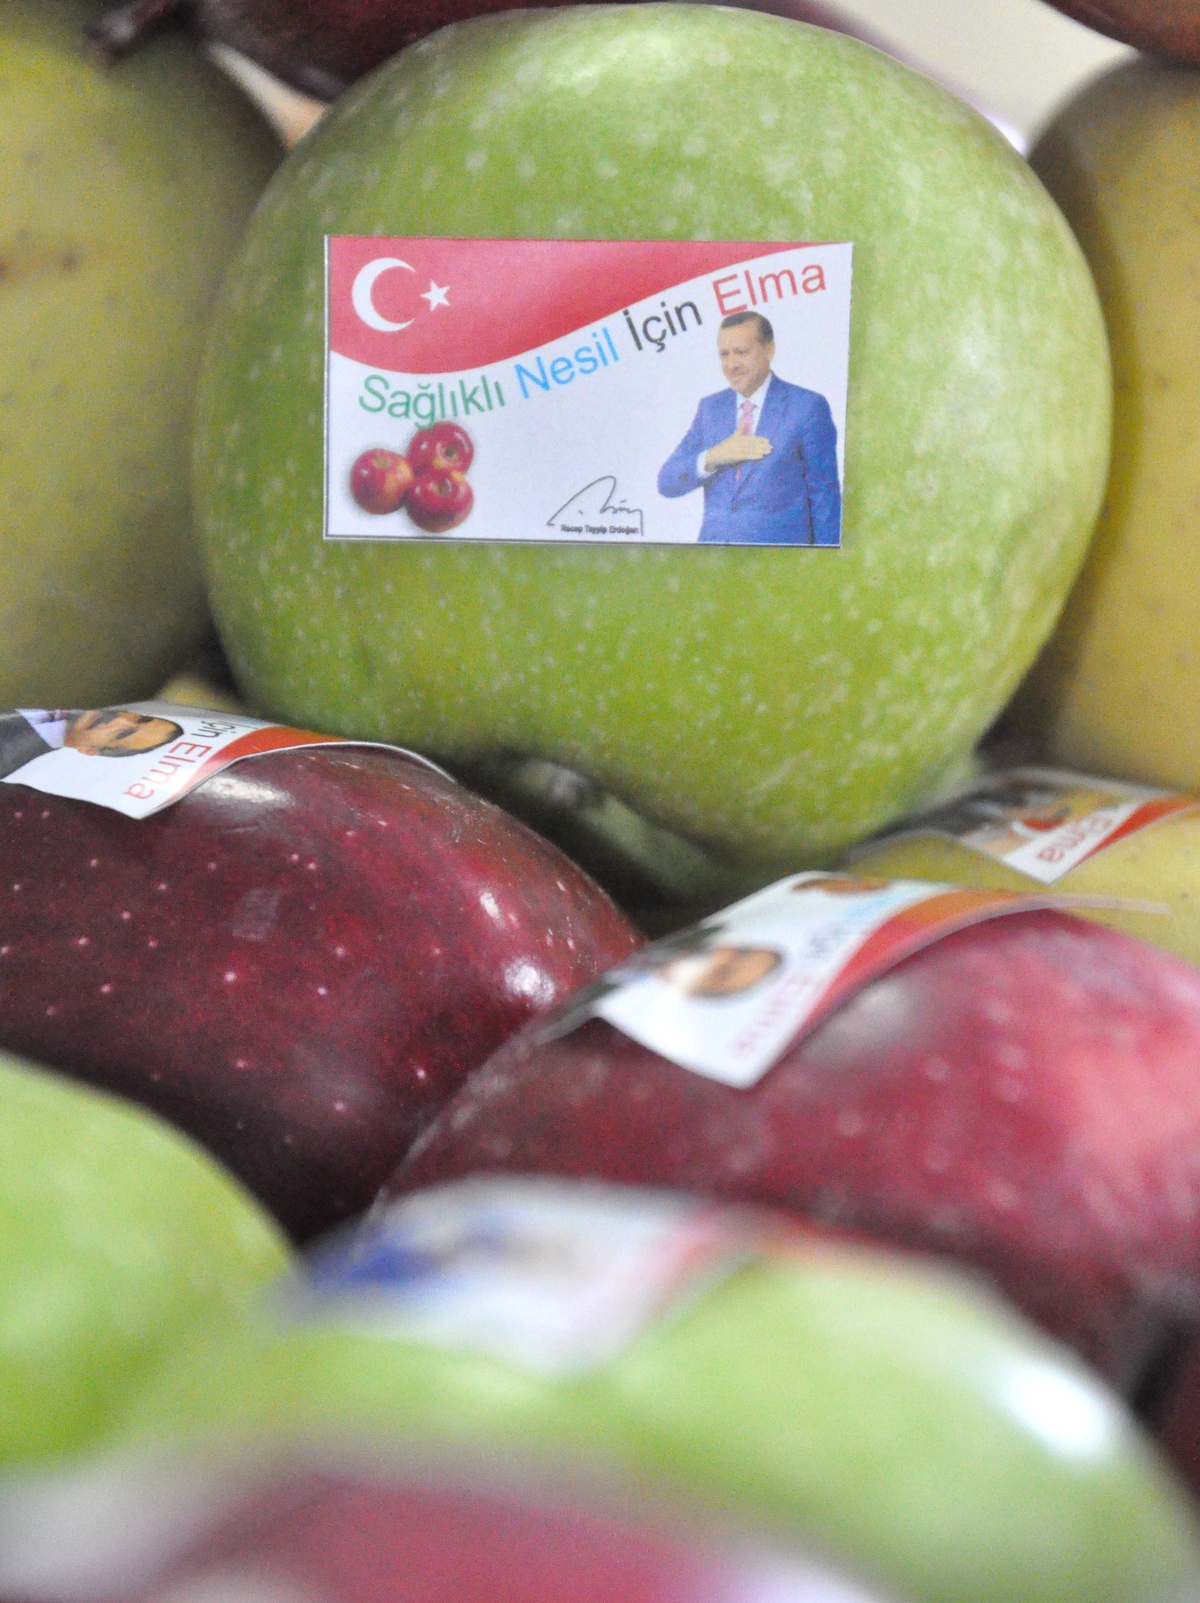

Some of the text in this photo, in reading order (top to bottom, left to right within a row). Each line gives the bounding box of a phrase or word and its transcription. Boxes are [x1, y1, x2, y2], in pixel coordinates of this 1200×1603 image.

[358, 262, 827, 431] Sağlıklı Nesil İçin Elma
[123, 741, 212, 800] Elma
